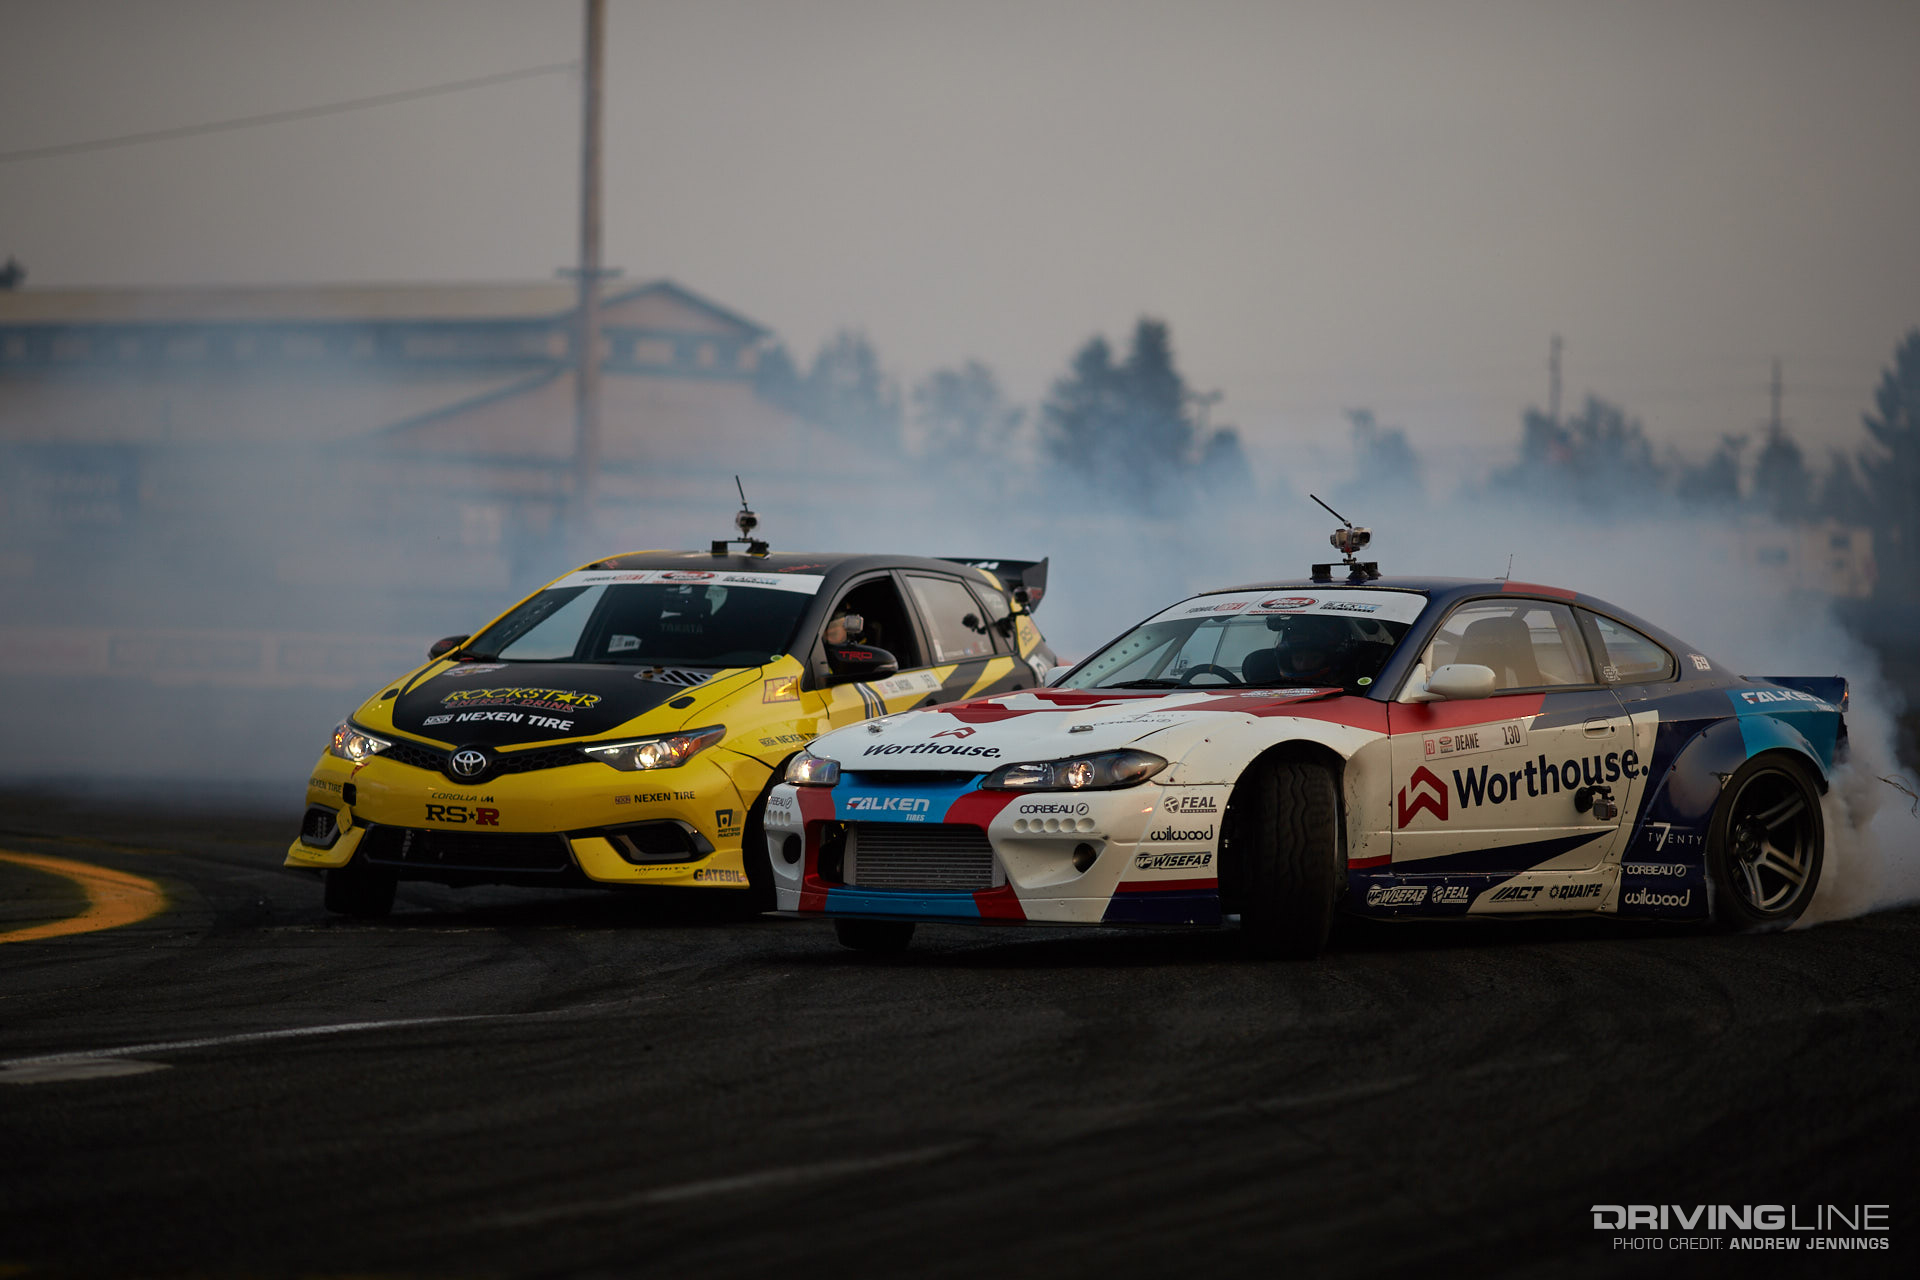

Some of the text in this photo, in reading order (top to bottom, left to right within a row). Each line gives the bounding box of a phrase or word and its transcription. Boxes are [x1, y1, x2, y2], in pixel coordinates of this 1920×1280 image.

[838, 650, 873, 660] TRD
[449, 697, 575, 712] ENERGY DRINK
[456, 711, 526, 724] NEXEN
[528, 714, 575, 732] TIRE
[1455, 733, 1480, 751] DEANE
[1502, 725, 1521, 746] 130
[863, 742, 1002, 759] Worthouse.
[1452, 749, 1649, 809] Worthouse.
[634, 792, 671, 803] NEXEN
[673, 791, 696, 801] TIRE
[1181, 796, 1217, 808] FEAL
[846, 797, 930, 812] FALKEN
[1020, 804, 1074, 814] CORBEAU
[905, 814, 925, 822] TIRES
[1150, 824, 1213, 841] wilwood
[1153, 854, 1212, 867] WISEFAB
[693, 869, 743, 882] GATEBIL
[1626, 865, 1673, 876] CORBEAU
[1443, 886, 1470, 899] FEAL
[1558, 883, 1603, 900] QUAIFE
[1624, 889, 1691, 907] wilwood
